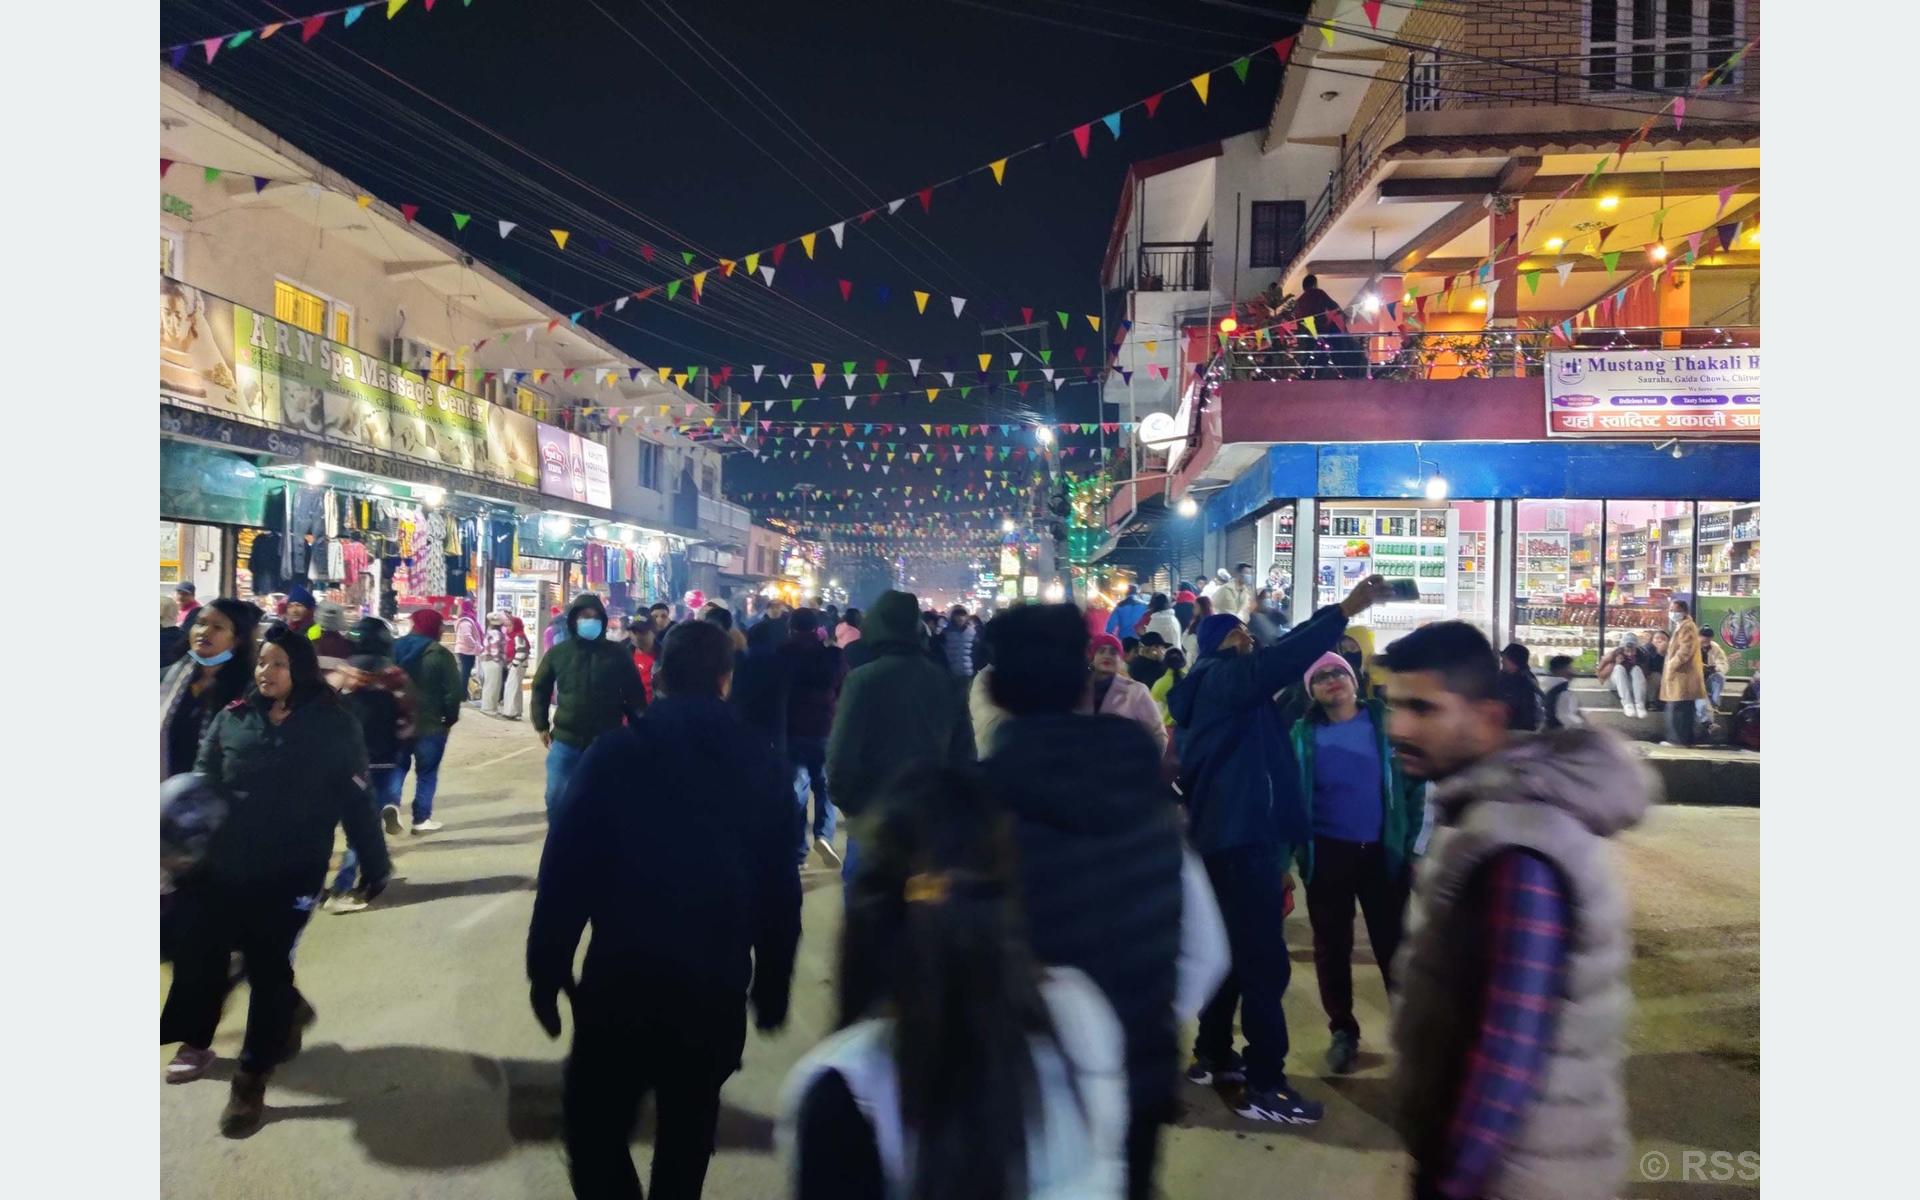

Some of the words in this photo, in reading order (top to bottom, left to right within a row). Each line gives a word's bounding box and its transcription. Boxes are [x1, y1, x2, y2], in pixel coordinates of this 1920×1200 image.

[250, 312, 269, 350] A
[274, 321, 292, 357] R
[296, 329, 315, 365] N
[320, 339, 355, 384] Spa
[359, 352, 434, 411] Massage
[437, 384, 484, 423] Center
[1588, 357, 1665, 375] Mustang
[1672, 355, 1741, 371] Thakali
[1675, 375, 1698, 383] Gaida
[1666, 411, 1726, 427] थकाली
[323, 447, 376, 473] JUNGLE
